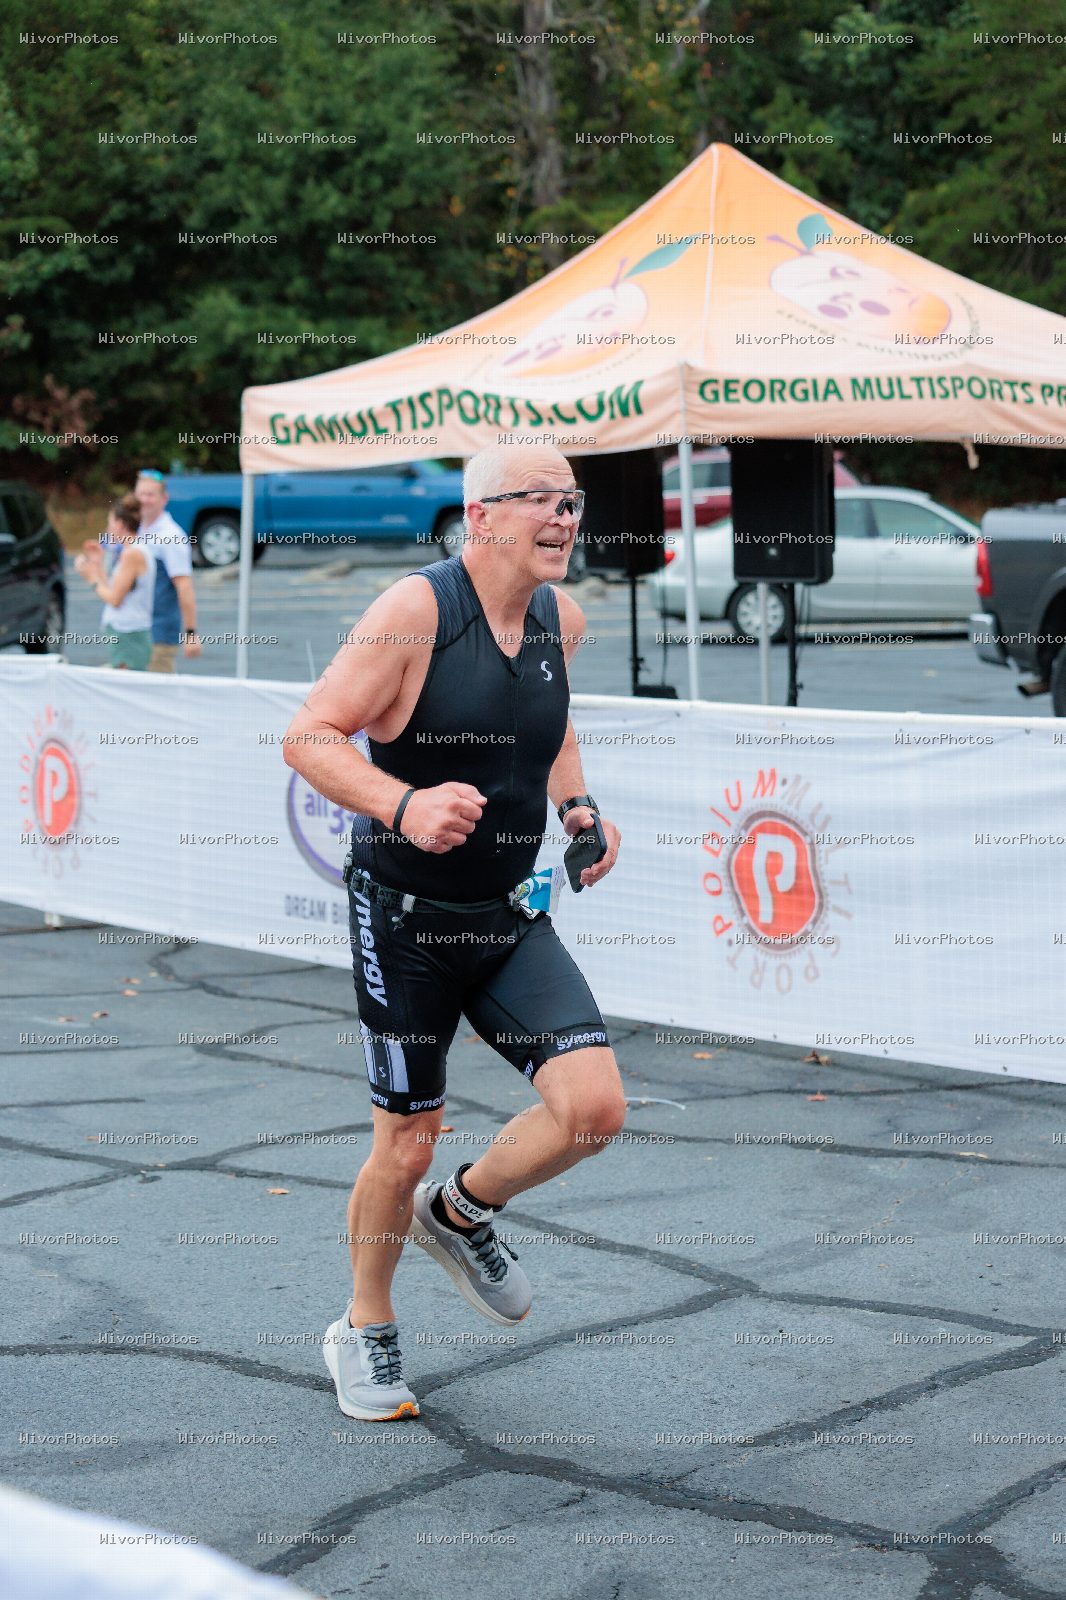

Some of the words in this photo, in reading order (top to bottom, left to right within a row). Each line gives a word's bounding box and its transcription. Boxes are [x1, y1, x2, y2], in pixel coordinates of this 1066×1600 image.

[269, 380, 644, 446] GAMULTISPORTS.COM
[699, 378, 843, 403] GEORGIA
[850, 376, 1034, 404] MULTISPORTS
[703, 767, 777, 938] PODIUM
